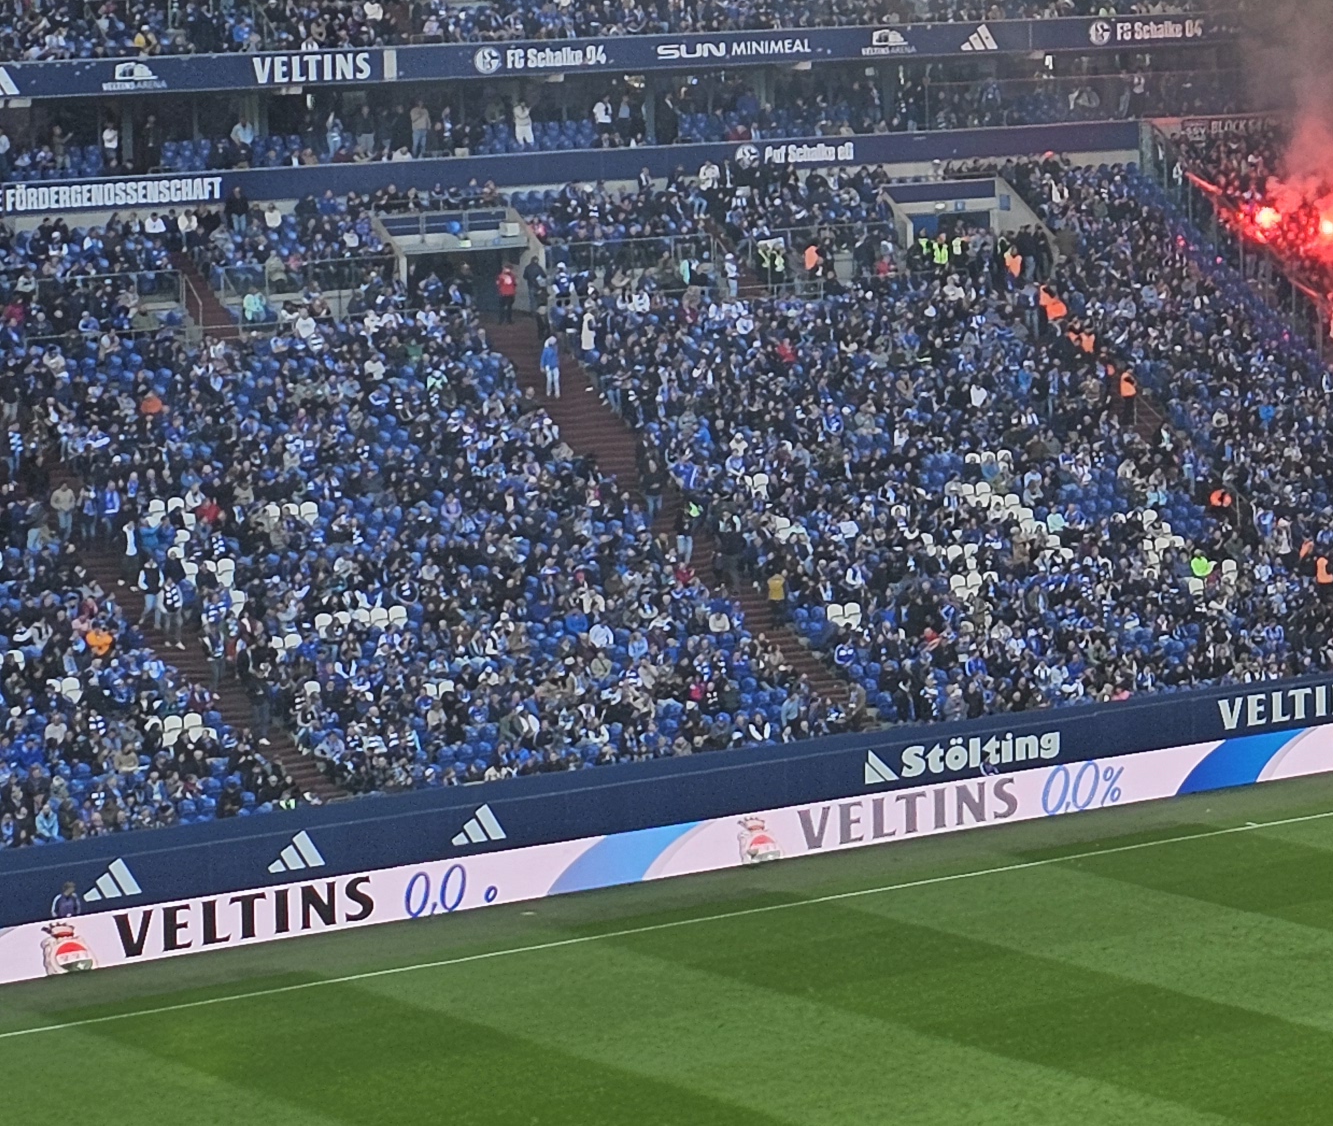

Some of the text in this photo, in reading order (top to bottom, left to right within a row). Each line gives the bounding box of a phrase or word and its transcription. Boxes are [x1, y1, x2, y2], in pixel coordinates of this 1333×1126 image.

[506, 43, 606, 69] FC Schalke 04
[656, 37, 811, 61] SUN MINIMEAL
[252, 52, 371, 85] VELTINS
[788, 143, 835, 162] Schalke
[5, 176, 222, 213] FÖRDERGENOSSENSCHAFT
[902, 728, 1061, 777] Stölting
[798, 777, 1018, 850] VELTINS
[112, 875, 375, 958] VELTINS
